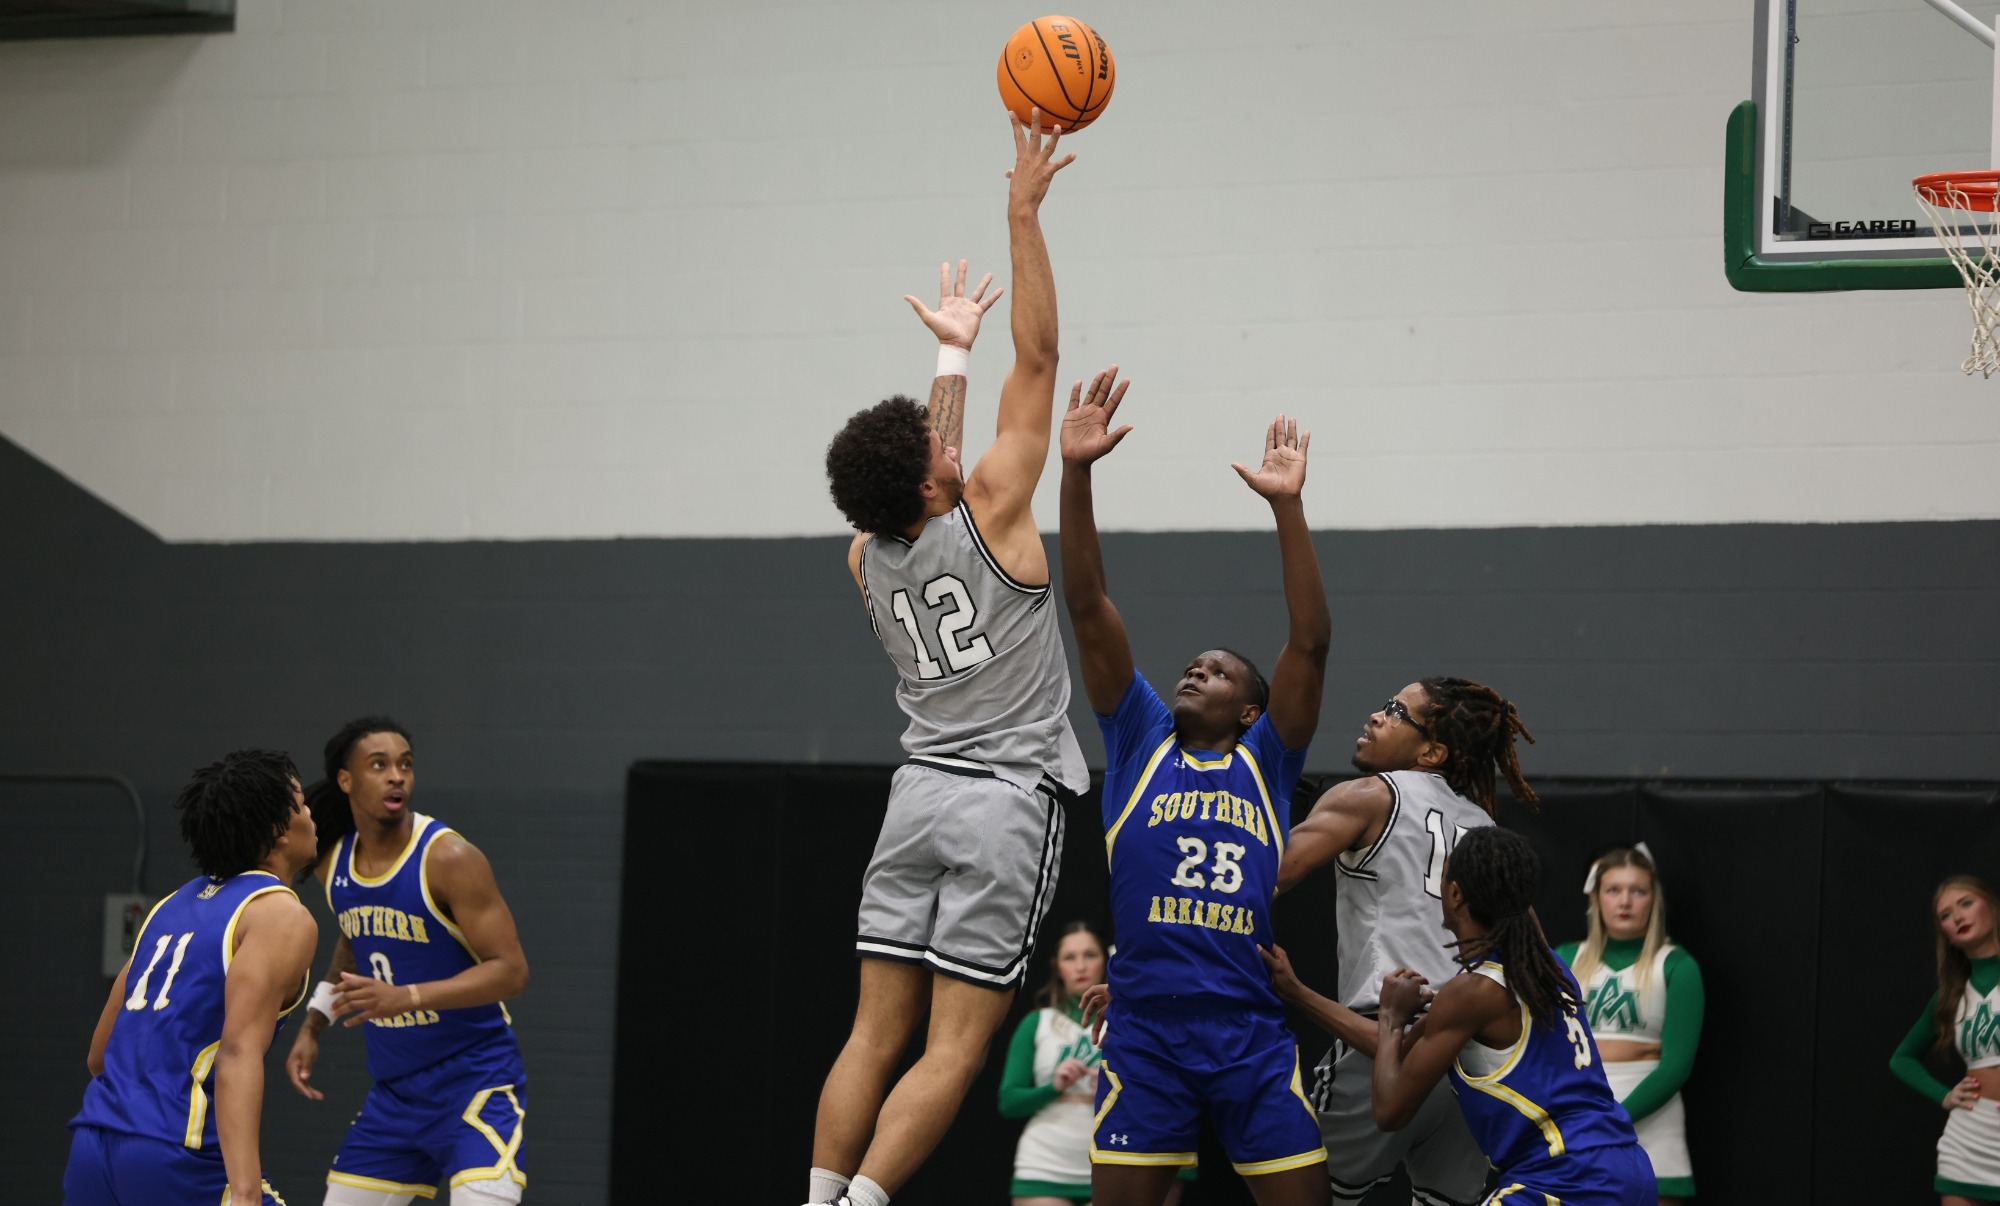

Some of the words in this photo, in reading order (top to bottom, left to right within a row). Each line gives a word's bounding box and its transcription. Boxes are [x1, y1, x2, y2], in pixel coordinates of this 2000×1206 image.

[1051, 24, 1080, 59] EVO
[1835, 219, 1916, 234] GARED
[891, 573, 996, 680] 12
[1170, 836, 1246, 894] 25
[1424, 807, 1470, 900] 1
[1147, 895, 1255, 935] ARKANSAS
[125, 931, 194, 1011] 11
